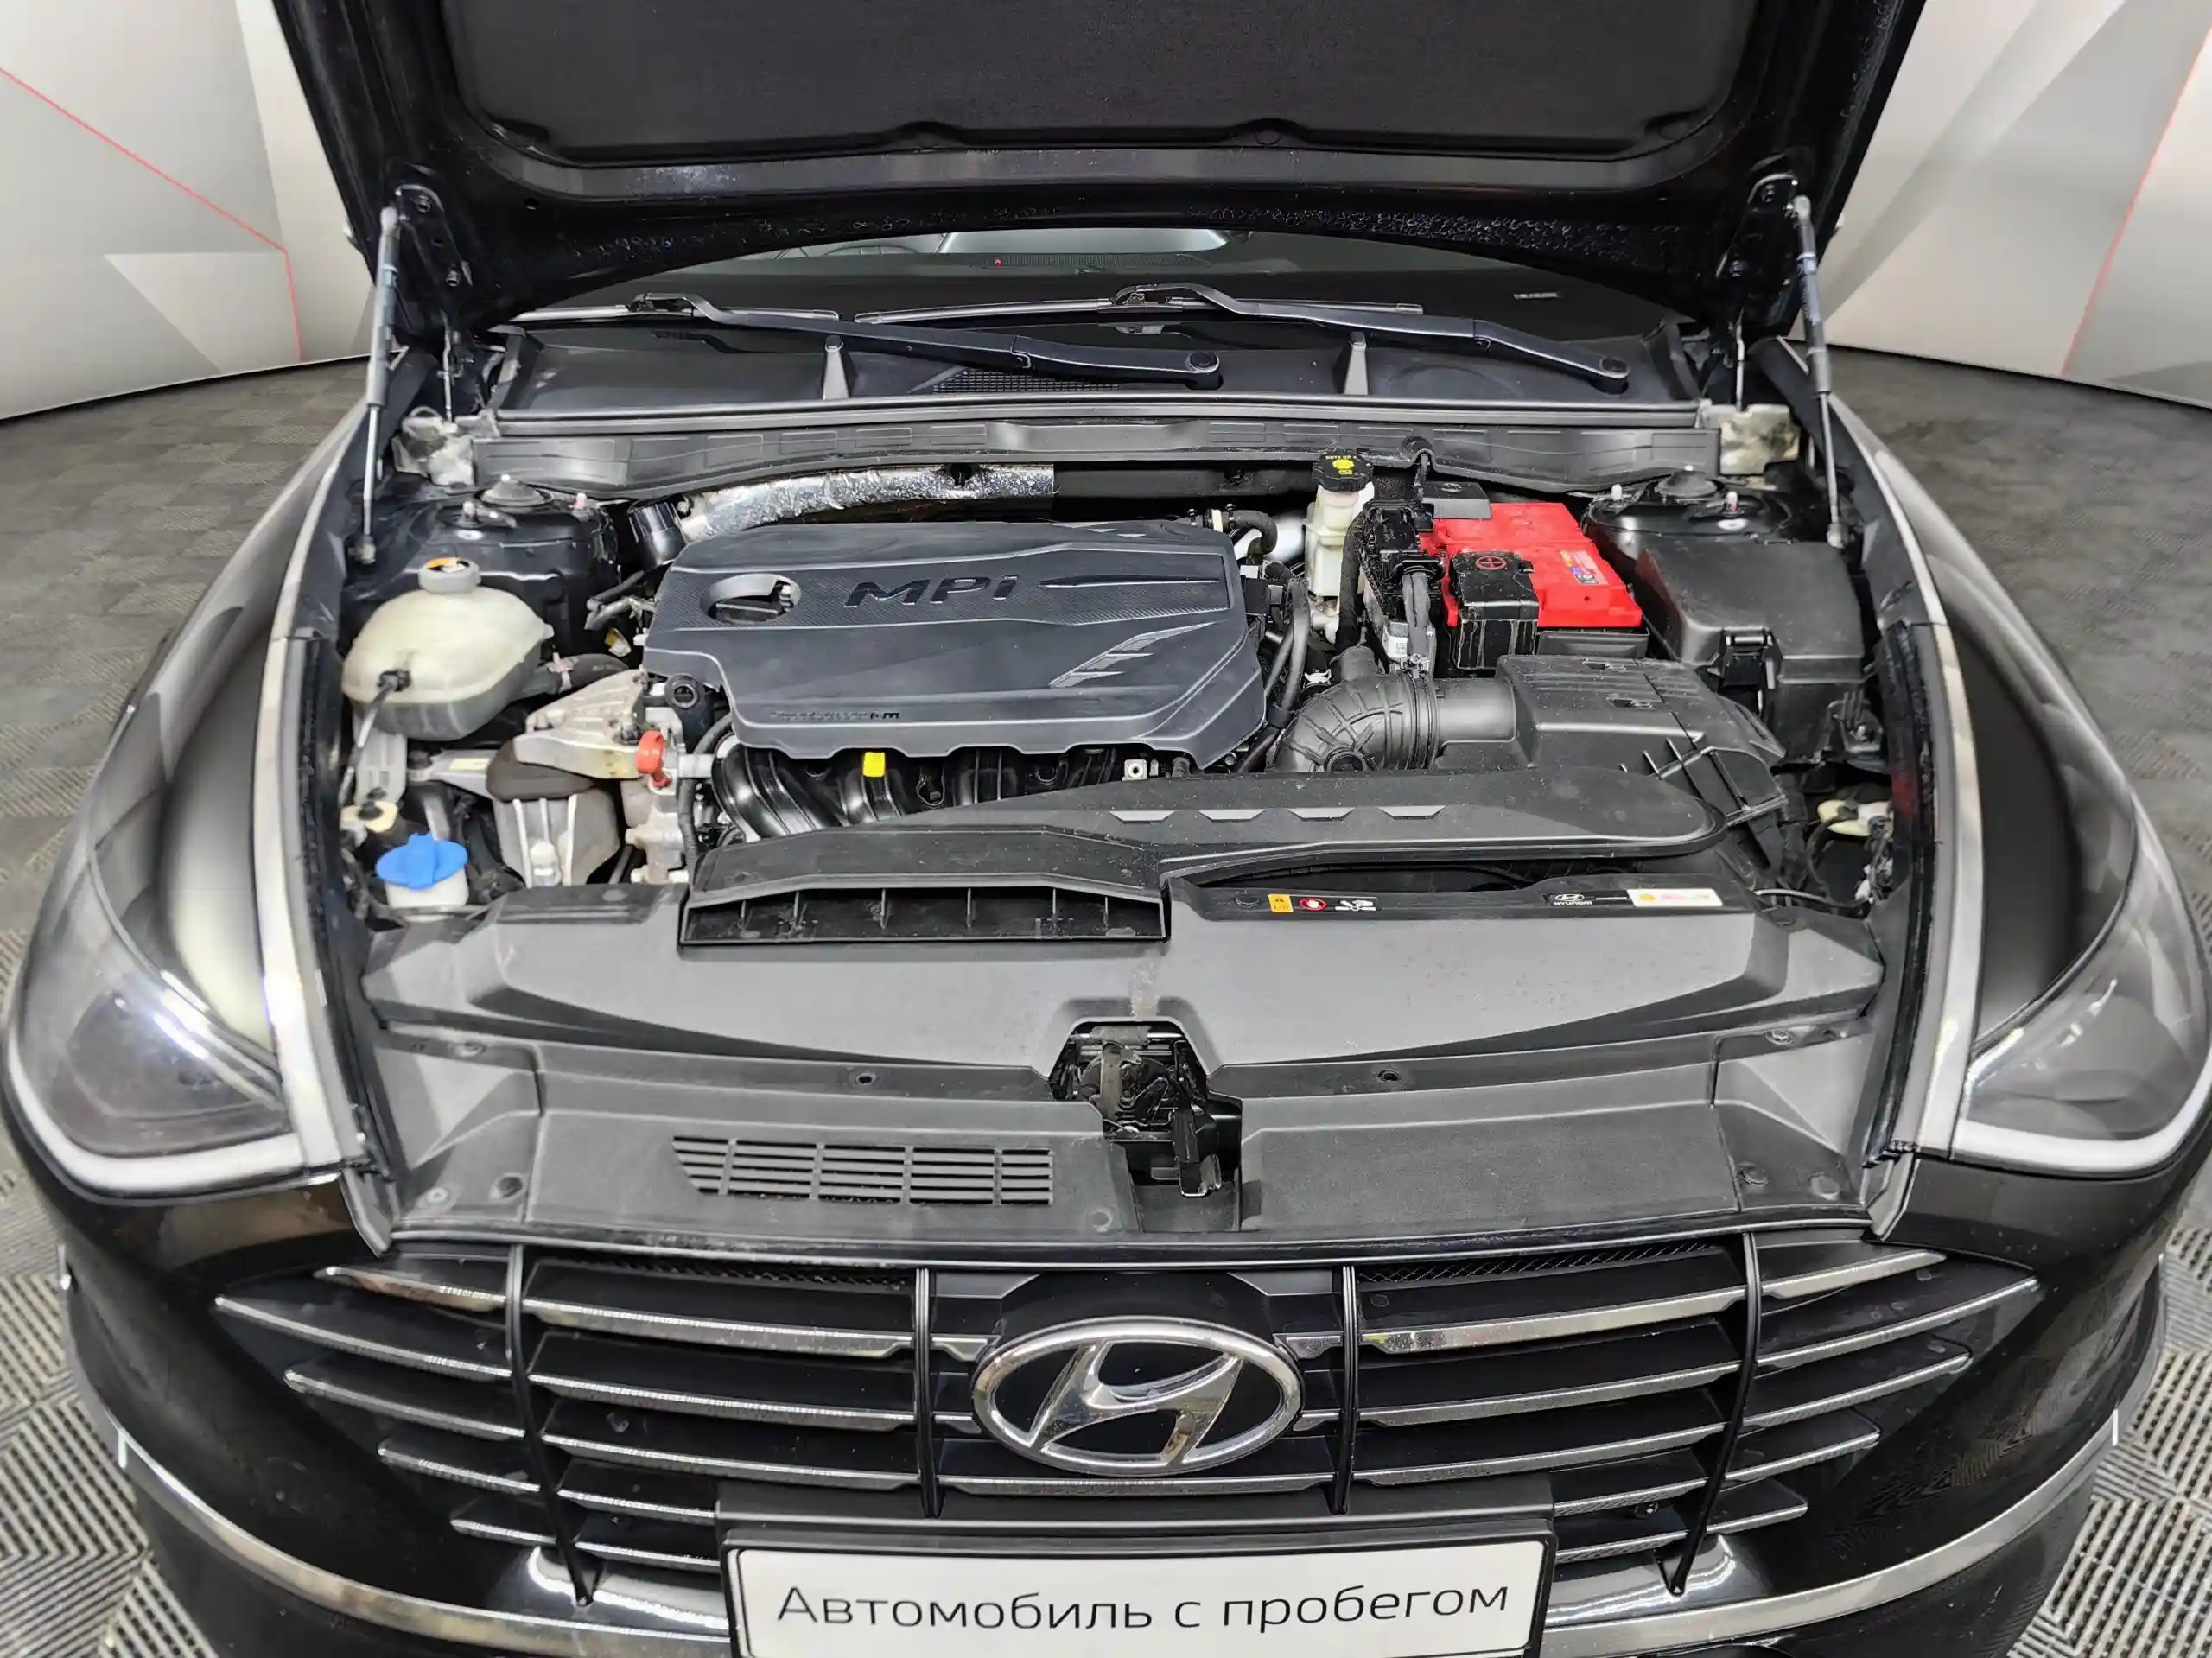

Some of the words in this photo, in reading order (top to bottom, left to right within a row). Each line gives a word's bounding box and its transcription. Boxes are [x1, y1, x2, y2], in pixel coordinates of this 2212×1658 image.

[778, 1586, 1154, 1629] Автомобиль
[1173, 1600, 1202, 1629] с
[1223, 1585, 1509, 1634] пробегом
